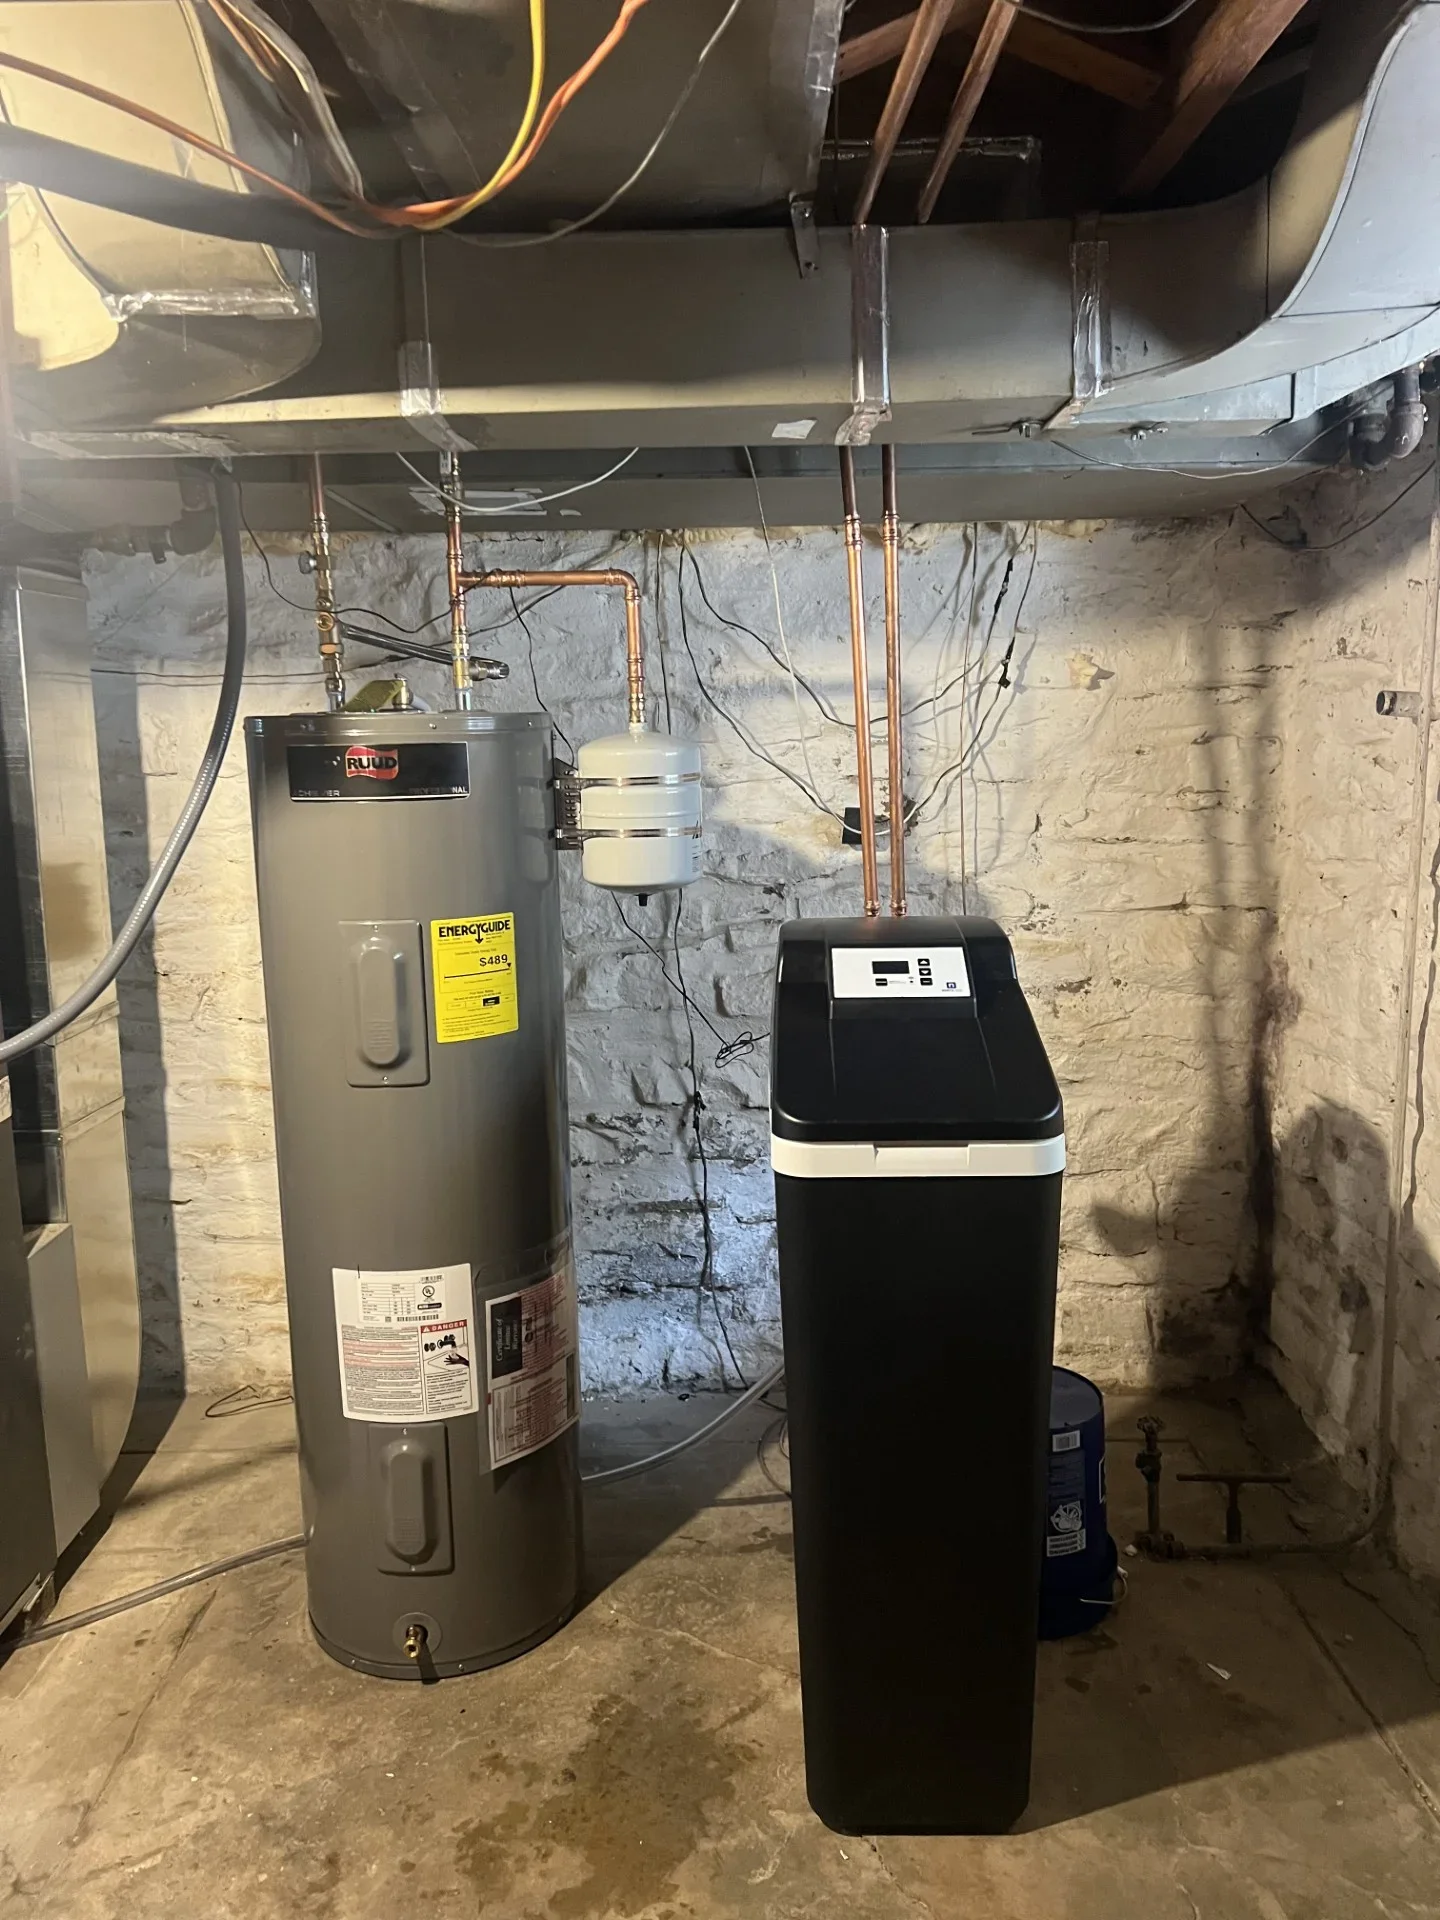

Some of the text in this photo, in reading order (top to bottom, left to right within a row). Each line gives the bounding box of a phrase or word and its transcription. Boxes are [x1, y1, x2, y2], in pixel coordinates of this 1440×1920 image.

[346, 756, 398, 770] RUUD
[291, 789, 341, 797] CHEER
[438, 919, 511, 939] ENERGYGUIDE
[431, 1321, 465, 1331] DANGER
[494, 1317, 504, 1327] of
